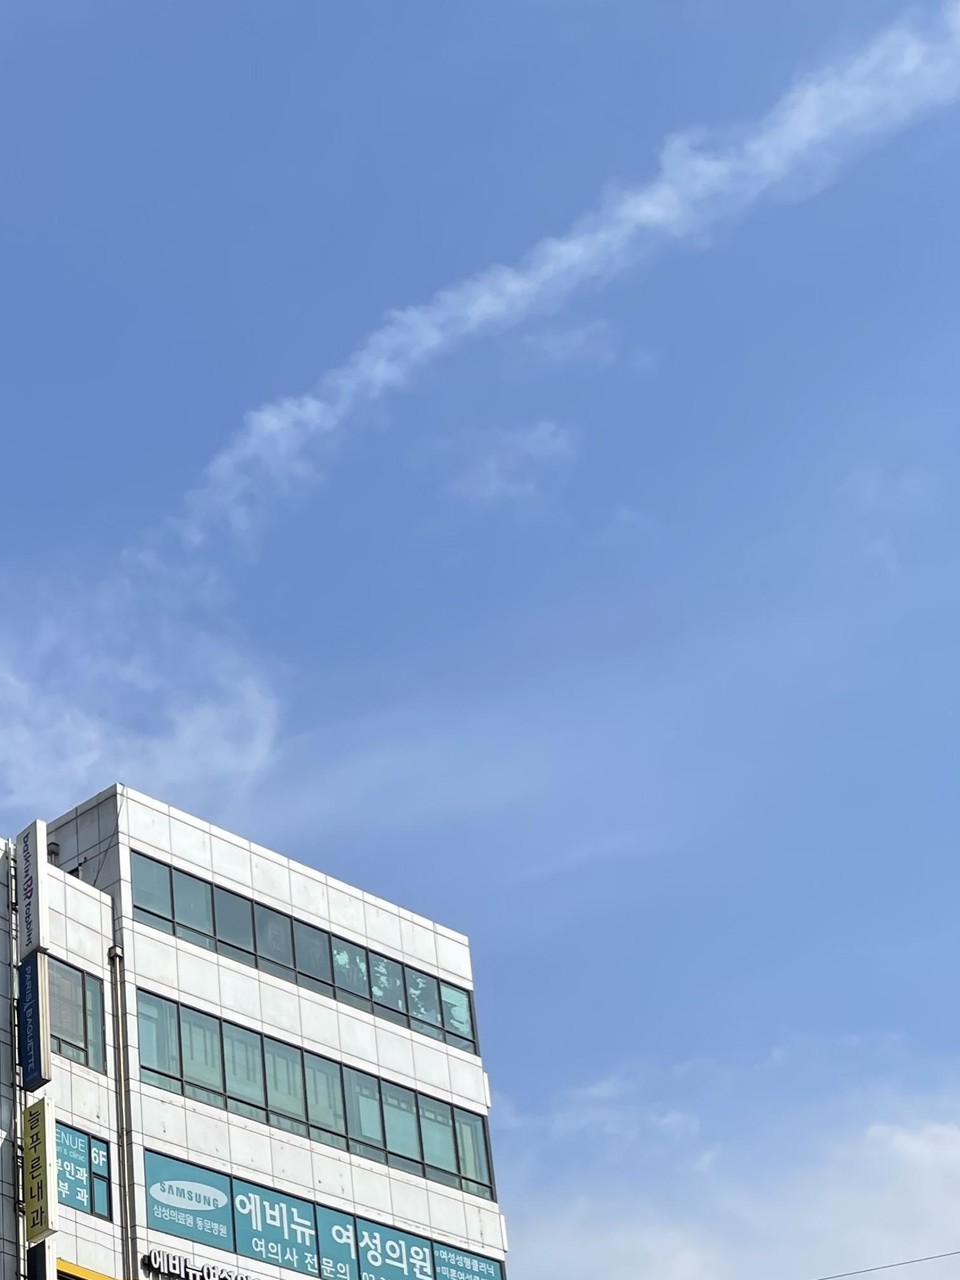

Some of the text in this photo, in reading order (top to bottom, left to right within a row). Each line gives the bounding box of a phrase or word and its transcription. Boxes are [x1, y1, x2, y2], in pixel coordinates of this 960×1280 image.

[28, 1111, 45, 1228] 늘푸른내과
[91, 1148, 107, 1167] 6F
[159, 1182, 220, 1208] SAMSUNG
[235, 1193, 316, 1246] 에비뉴
[252, 1237, 299, 1268] 여의사
